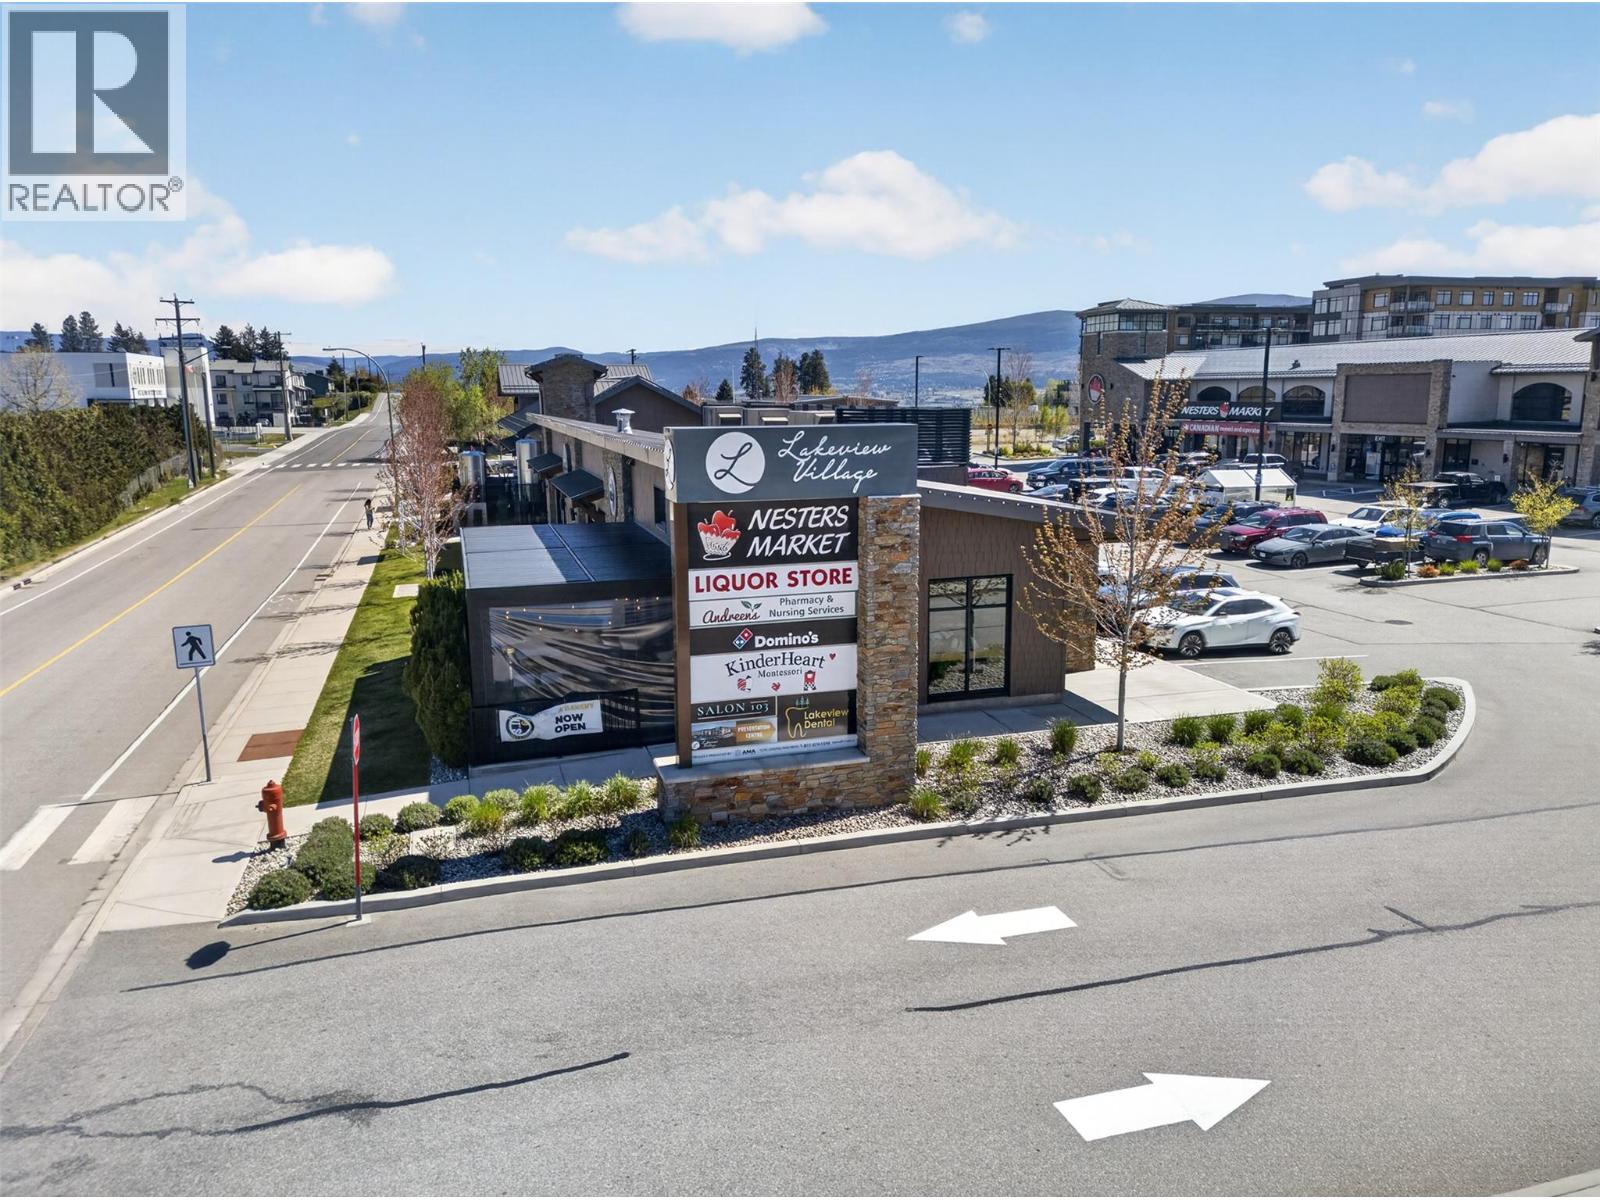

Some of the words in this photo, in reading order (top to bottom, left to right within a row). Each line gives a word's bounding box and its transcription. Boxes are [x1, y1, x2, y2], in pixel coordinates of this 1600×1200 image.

[1181, 405, 1220, 416] NESTERS
[778, 430, 892, 461] Lakeview
[793, 458, 878, 494] Village
[747, 505, 850, 531] NESTERS
[746, 532, 851, 558] MARKET
[694, 571, 779, 594] LIQUOR
[787, 567, 853, 588] STORE
[779, 596, 825, 607] Pharmacy
[827, 594, 834, 603] &
[769, 608, 805, 618] Nursing
[807, 605, 845, 616] Services
[754, 631, 819, 648] Domino's
[724, 651, 826, 677] KinderHeart
[757, 668, 803, 678] Montessori
[697, 702, 745, 717] SALON
[750, 703, 769, 713] 103
[804, 709, 849, 720] Lakeview
[554, 713, 584, 724] NOW
[804, 718, 836, 729] Dental
[554, 722, 587, 733] OPEN
